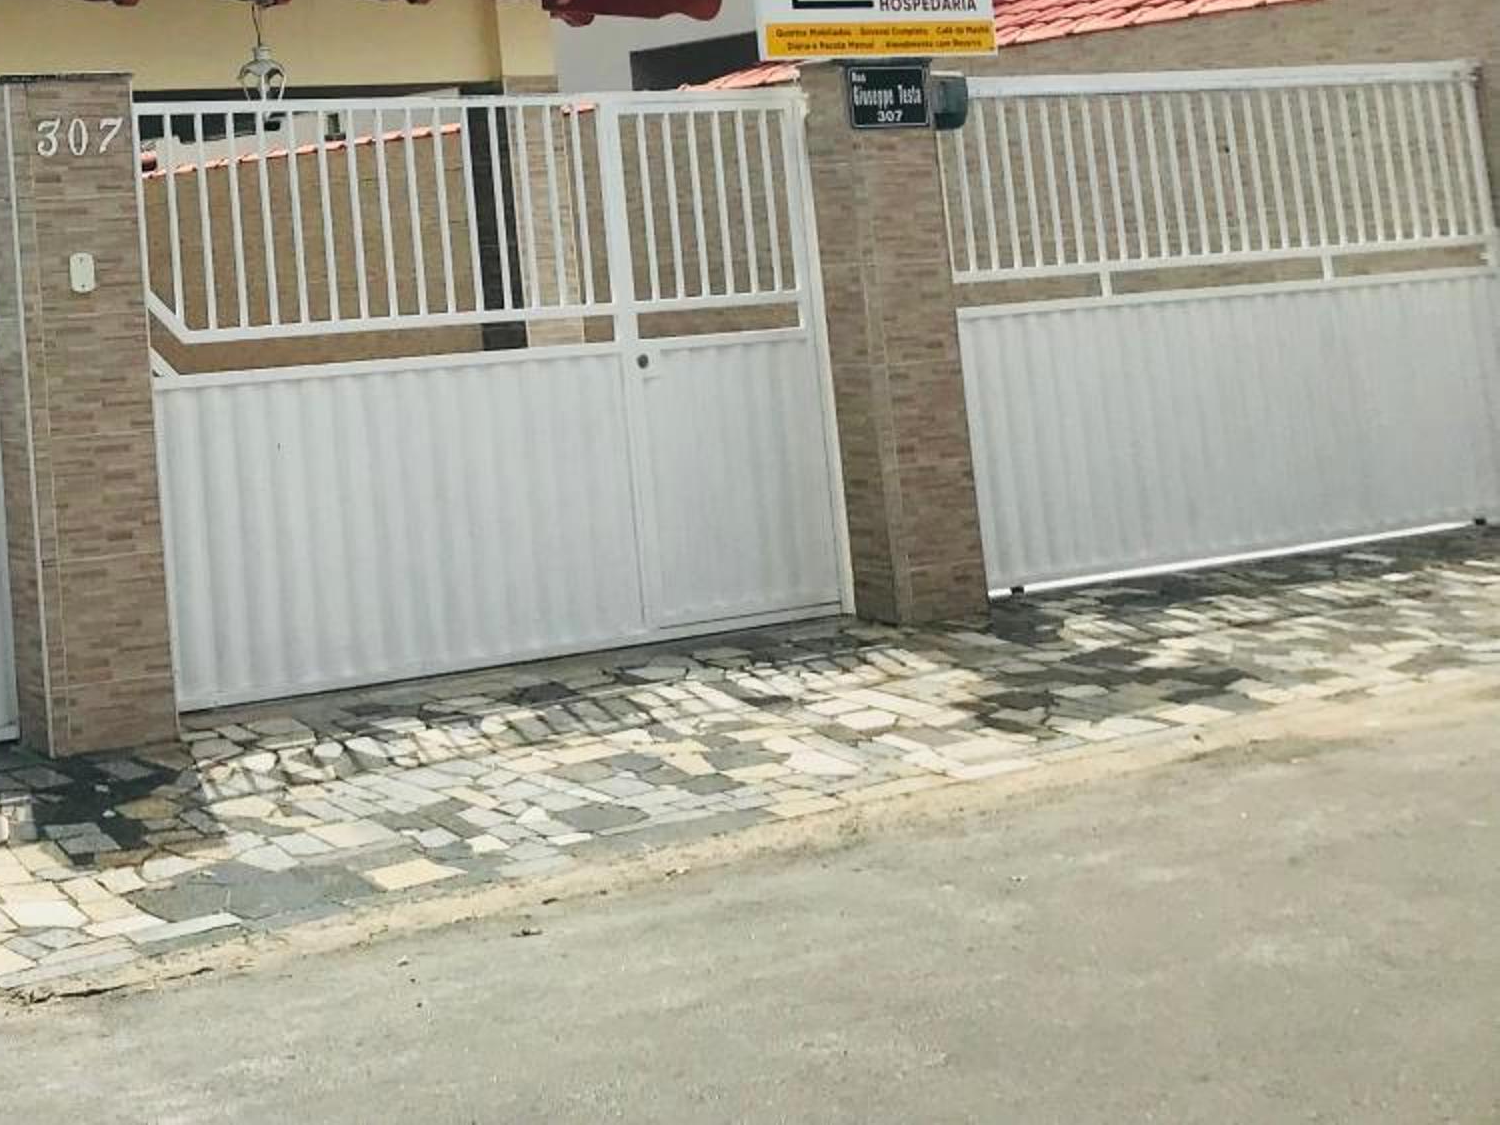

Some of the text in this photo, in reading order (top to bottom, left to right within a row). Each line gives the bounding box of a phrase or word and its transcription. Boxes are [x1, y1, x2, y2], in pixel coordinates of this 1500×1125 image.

[897, 84, 921, 105] Testa
[877, 110, 903, 122] 307
[37, 117, 124, 157] 307
